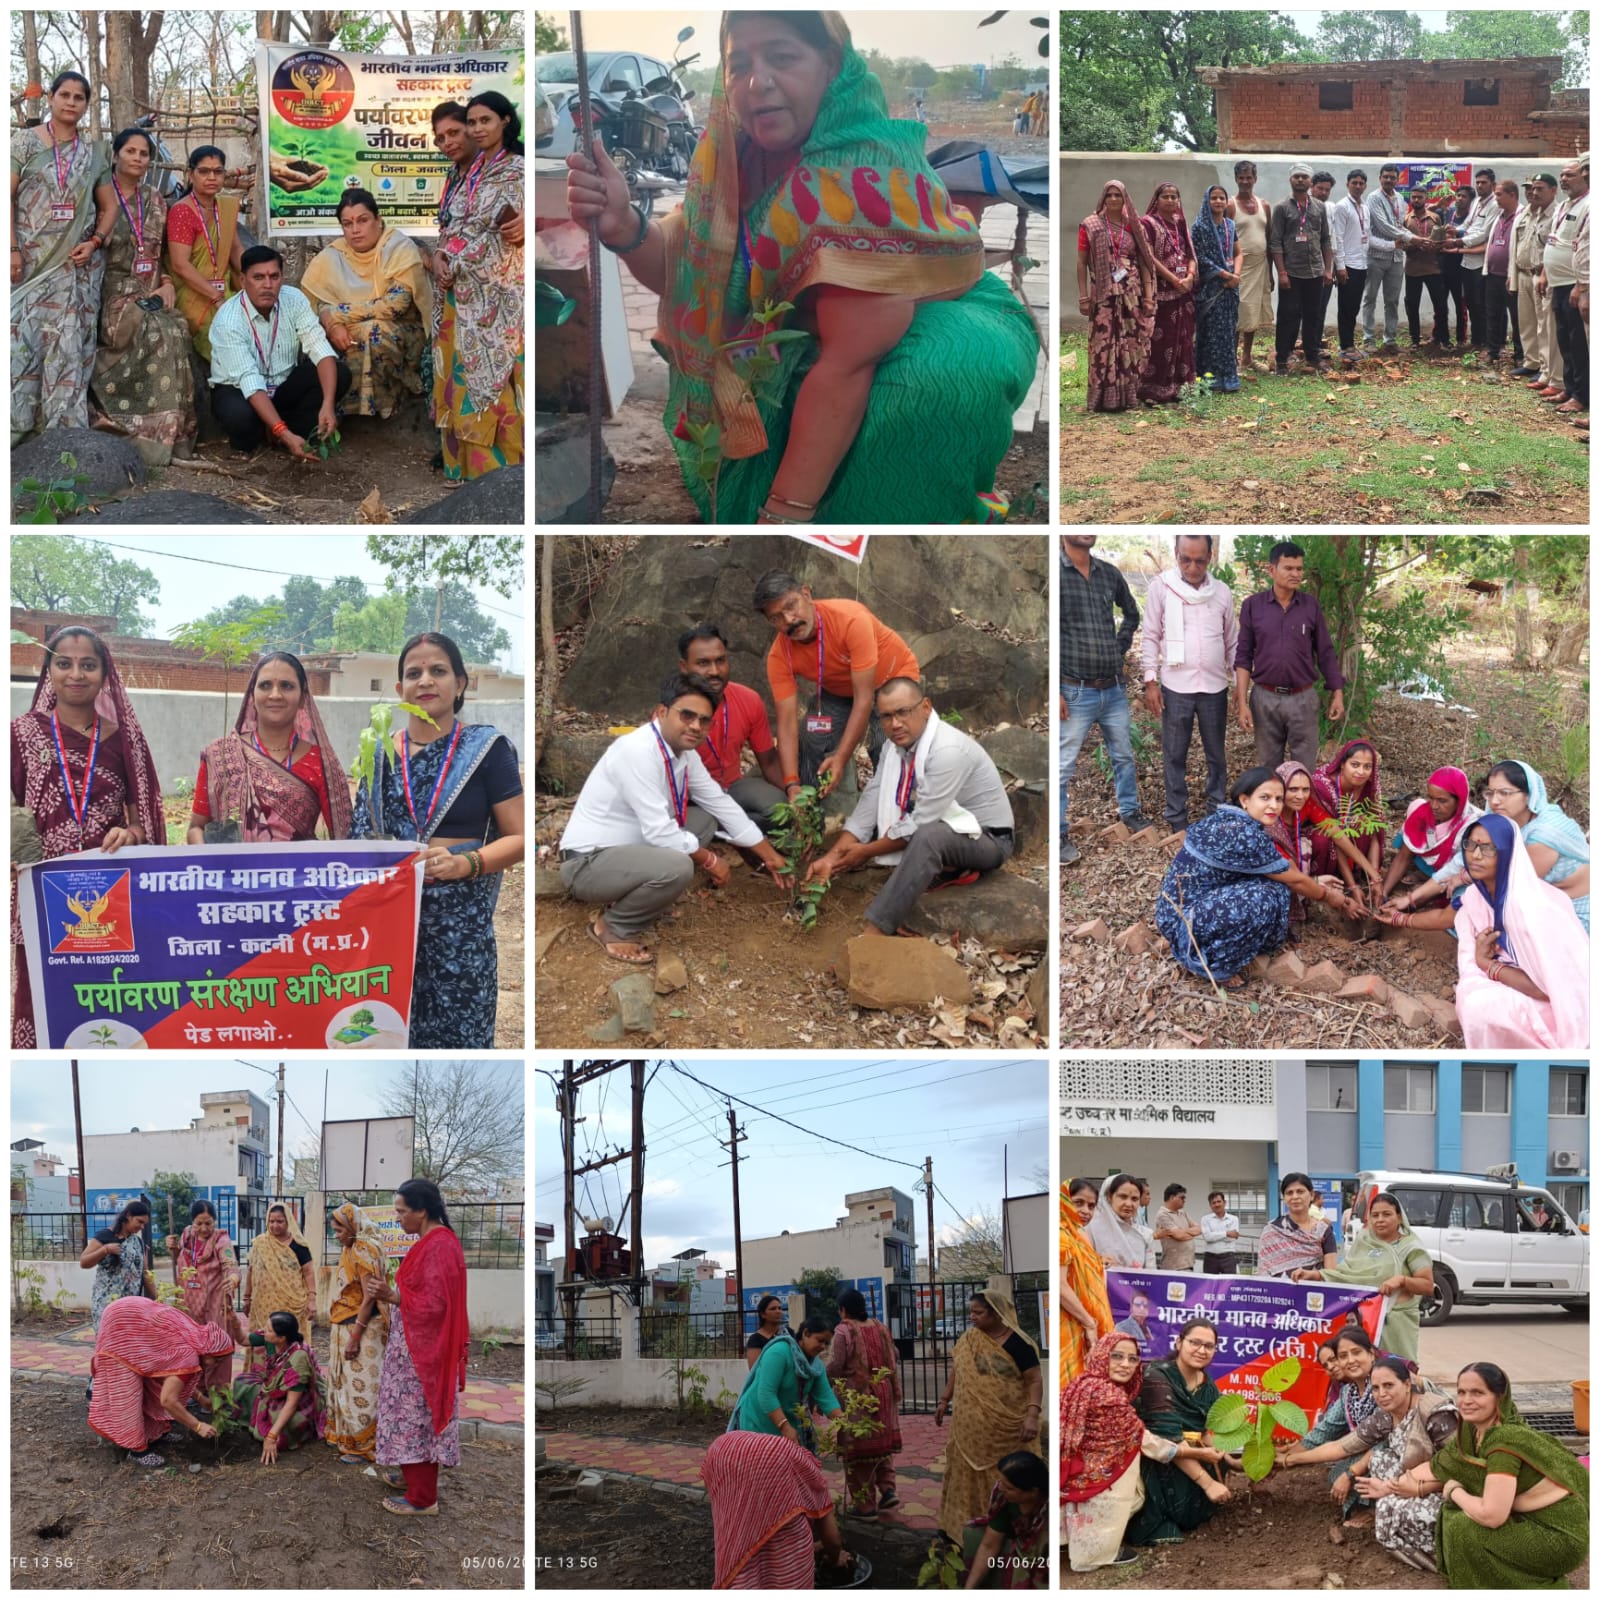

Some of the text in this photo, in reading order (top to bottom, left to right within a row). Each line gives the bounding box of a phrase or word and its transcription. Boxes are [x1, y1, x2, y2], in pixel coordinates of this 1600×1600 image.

[361, 62, 410, 74] भारतीय
[415, 63, 450, 74] मानव
[454, 59, 509, 73] अधिकार
[396, 79, 442, 91] सहकार
[366, 128, 427, 148] जीवन
[380, 164, 407, 173] जिला
[139, 865, 226, 893] भारतीय
[231, 868, 296, 891] मानव
[304, 862, 398, 889] अधिकार
[198, 899, 341, 927] सहकार ट्रस्ट
[168, 937, 221, 957] जिला
[241, 932, 294, 955] कटनी
[303, 927, 370, 955] (म.प्र.)
[48, 956, 68, 965] Govt.
[74, 962, 393, 1014] पर्यावरण संरक्षण अभियान
[1172, 1105, 1216, 1123] विद्यालय
[1157, 1304, 1333, 1334] भारतीय मानव अधिकार
[1233, 1337, 1265, 1358] ट्रस्ट
[1229, 1373, 1262, 1386] M. NO.
